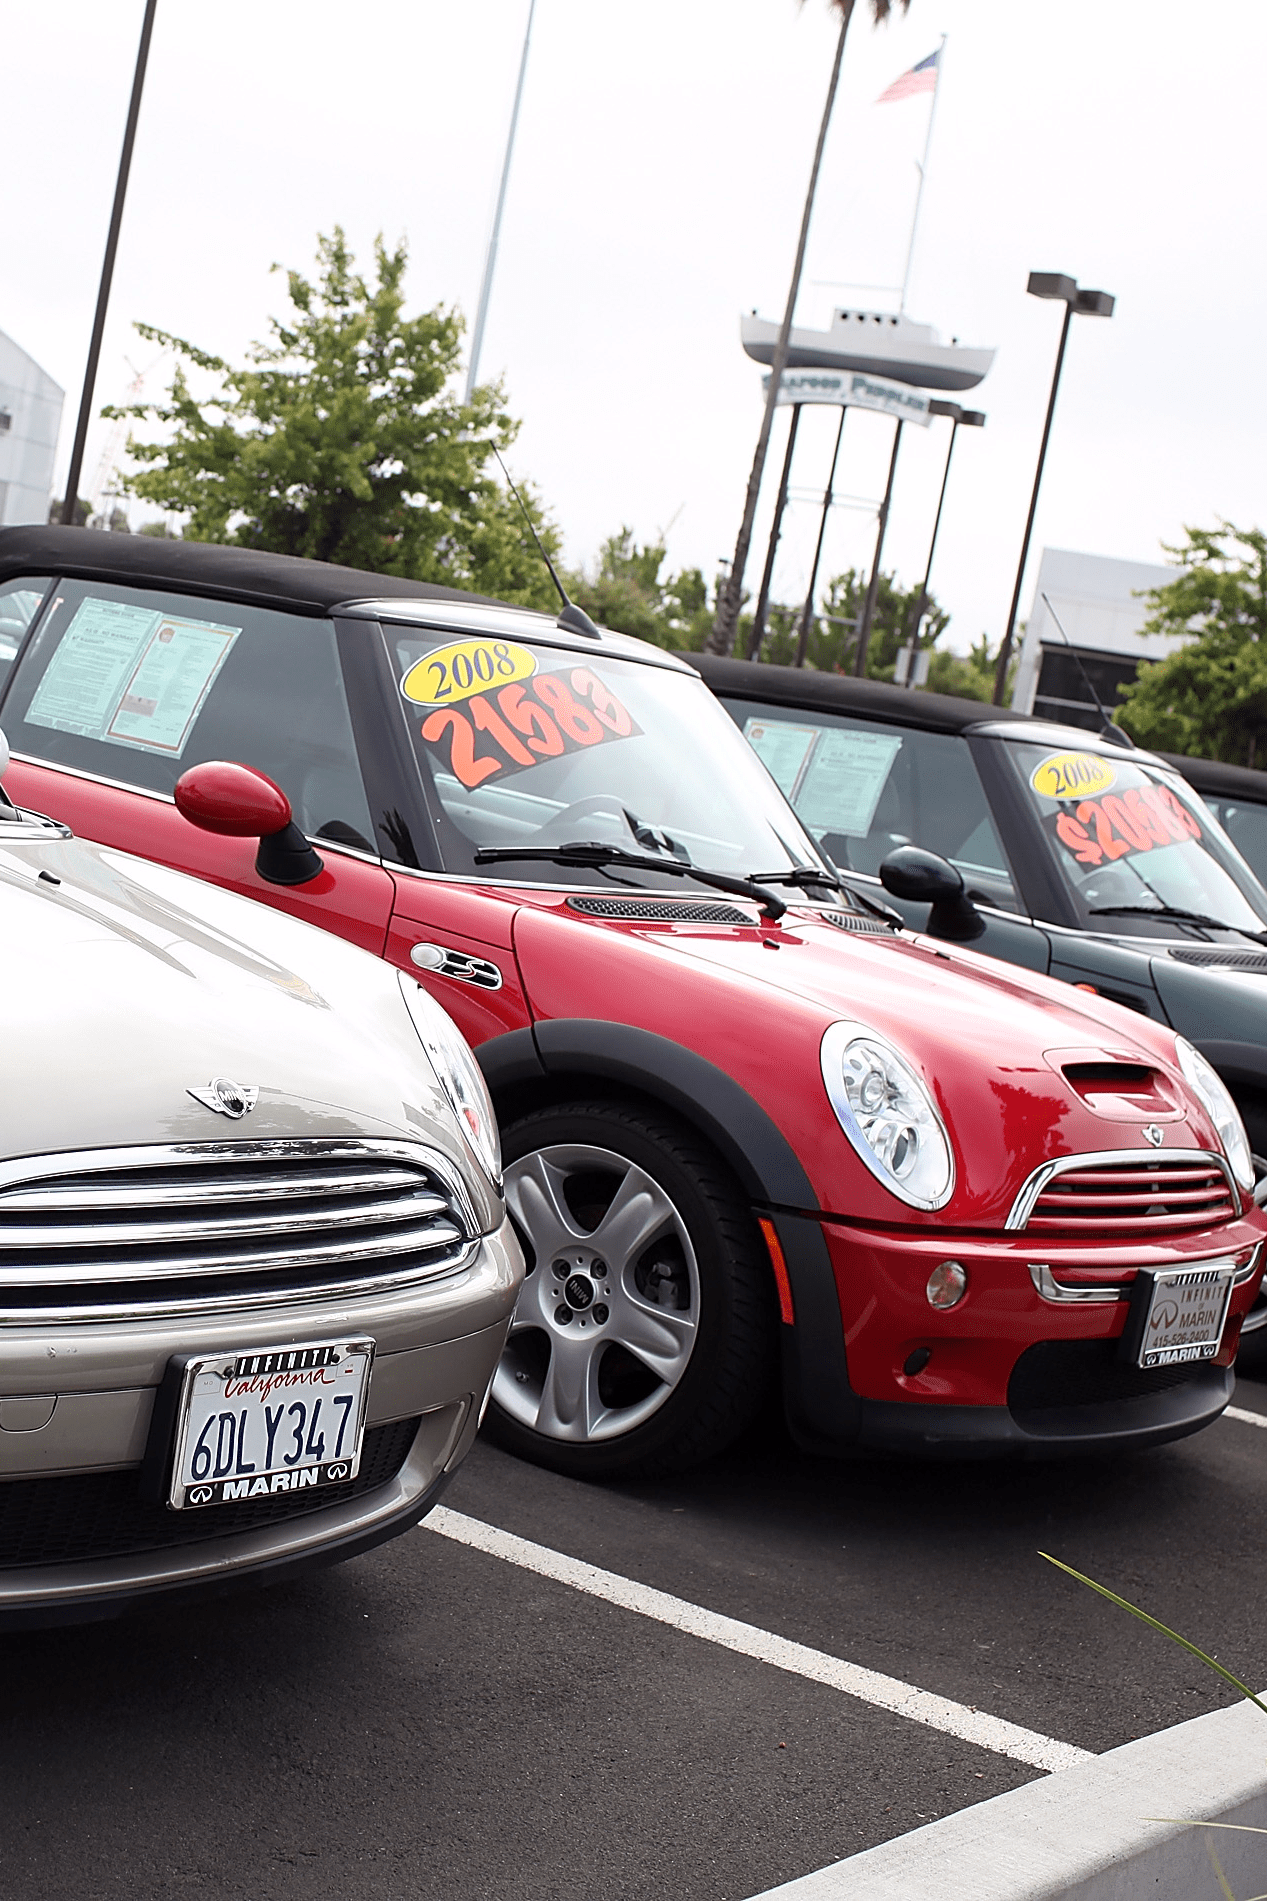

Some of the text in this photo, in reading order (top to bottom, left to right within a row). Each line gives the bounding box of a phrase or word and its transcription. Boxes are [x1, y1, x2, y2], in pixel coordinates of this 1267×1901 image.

[427, 643, 516, 699] 2008
[421, 668, 633, 787] 21583
[1048, 757, 1105, 795] 2008
[569, 1279, 589, 1304] MINI
[1181, 1286, 1226, 1303] INFINIT
[1179, 1310, 1216, 1328] MARIN
[1153, 1329, 1209, 1347] 415-526-2400
[239, 1349, 330, 1375] INFINITI
[1158, 1346, 1201, 1364] MARIN
[224, 1368, 335, 1402] California
[191, 1395, 354, 1481] 6DLY347
[222, 1467, 319, 1501] MARIN
